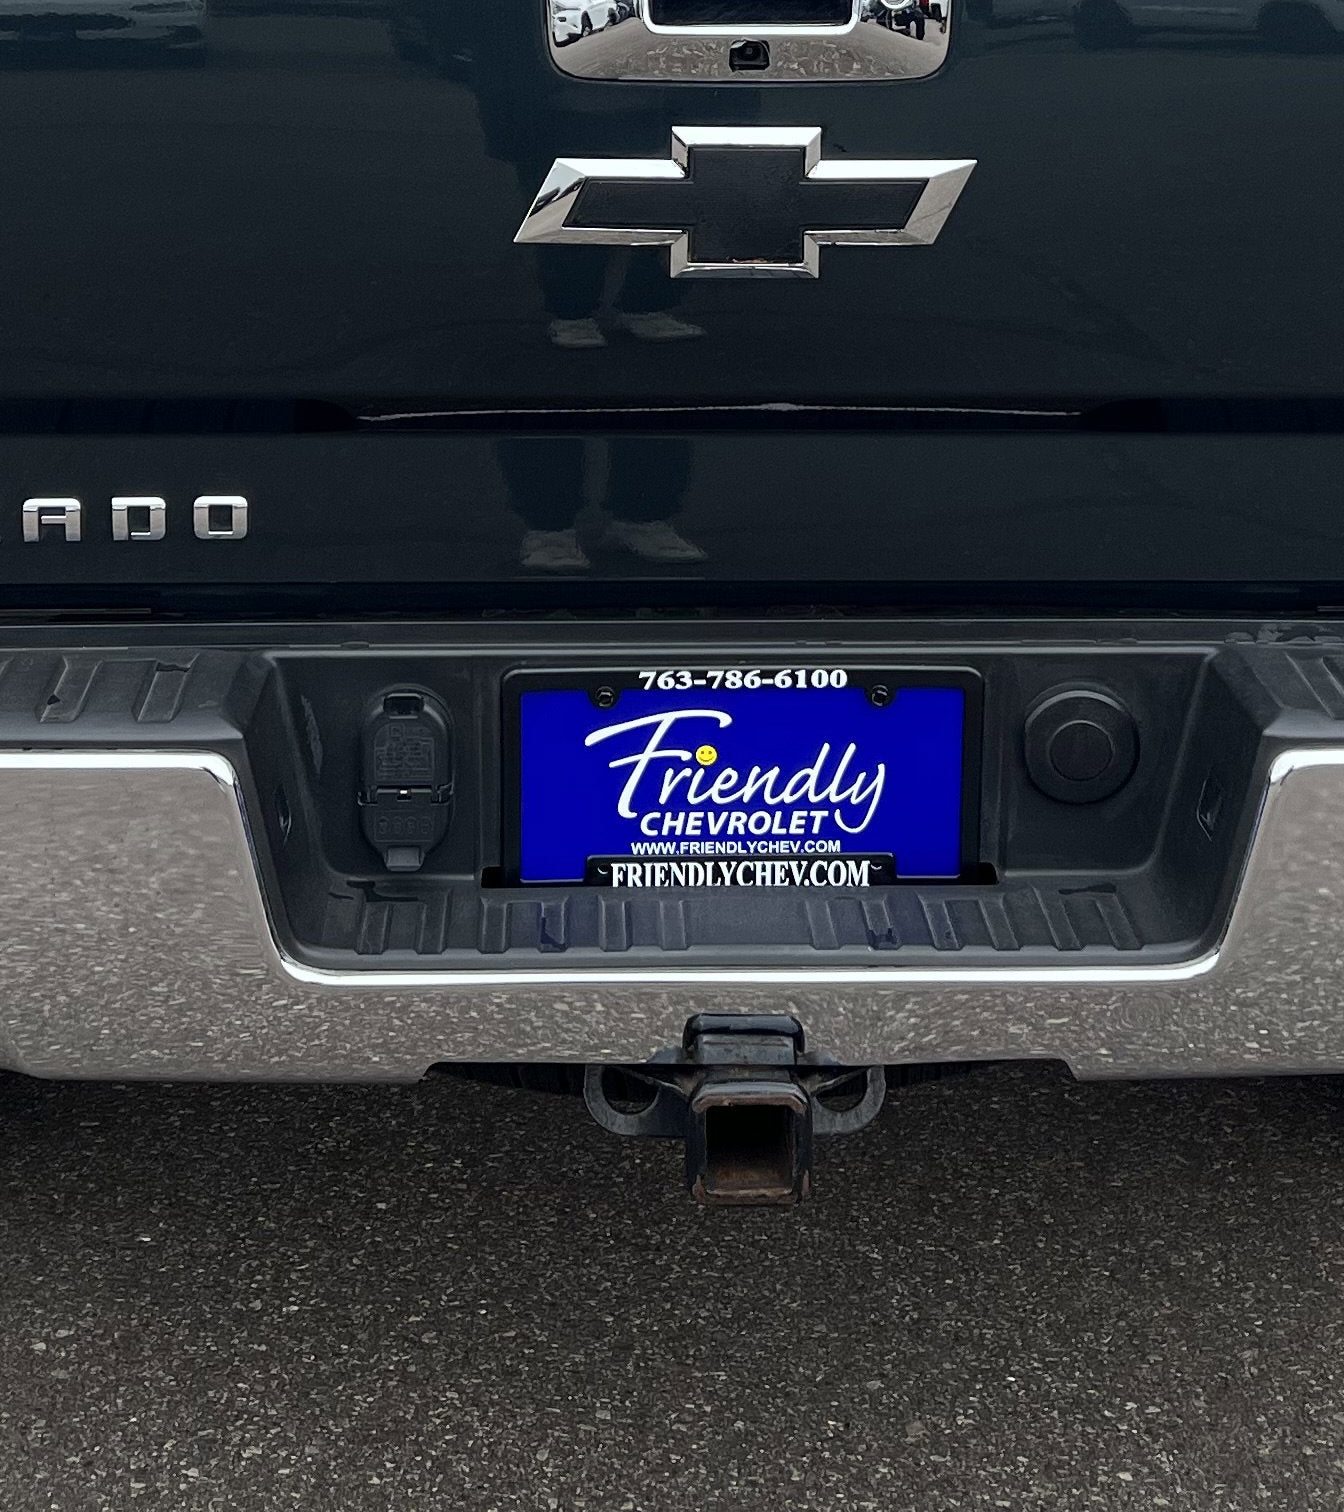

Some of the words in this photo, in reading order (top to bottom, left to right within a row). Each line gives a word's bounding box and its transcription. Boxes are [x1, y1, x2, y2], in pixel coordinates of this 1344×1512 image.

[638, 669, 848, 690] 763-786-6100
[584, 709, 886, 834] Friendly
[640, 810, 829, 837] CHEVROLET
[631, 839, 841, 855] WWW.FRIENDLYCHEV.COM
[611, 860, 871, 888] FRIENDLYCHEV.COM
